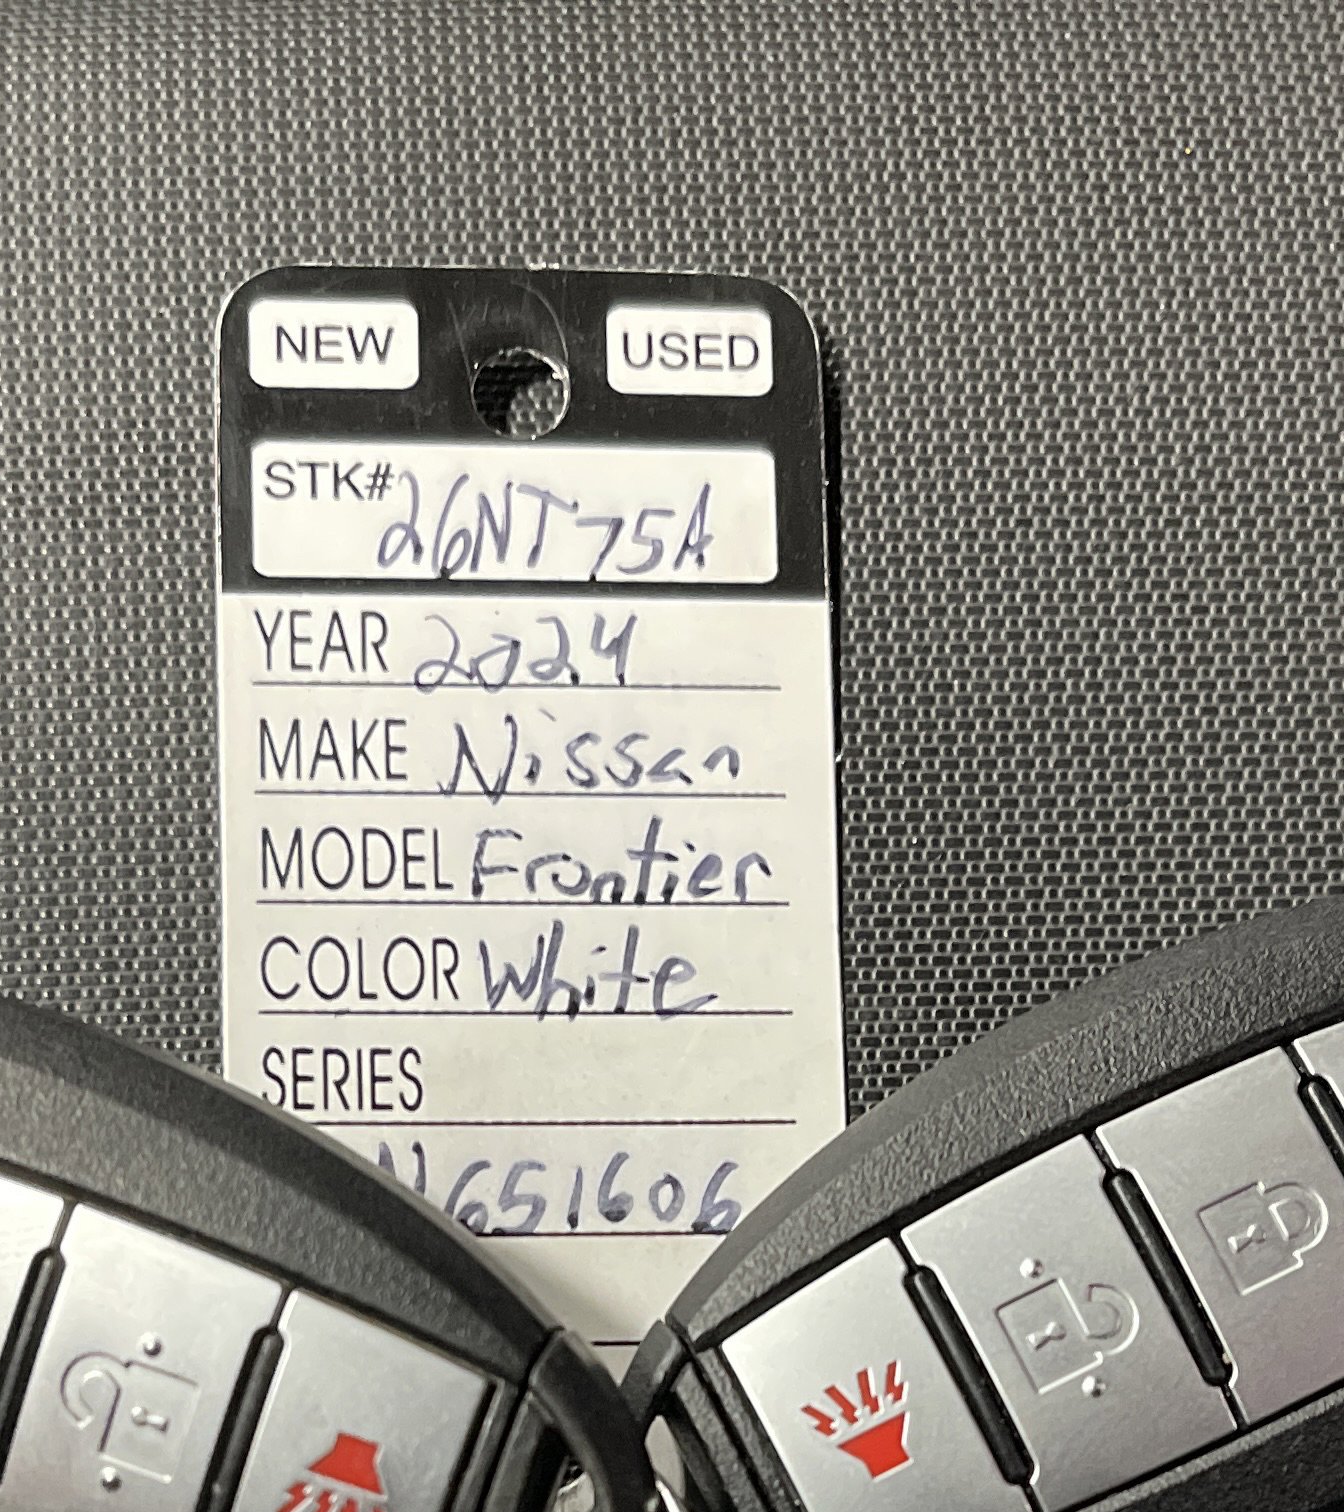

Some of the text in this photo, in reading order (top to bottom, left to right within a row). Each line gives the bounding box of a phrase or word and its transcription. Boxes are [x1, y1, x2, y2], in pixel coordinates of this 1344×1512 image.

[274, 325, 395, 363] NEW
[622, 331, 760, 371] USED
[264, 460, 394, 501] STK#
[254, 610, 389, 673] YEAR
[413, 612, 638, 693] 2024
[258, 718, 408, 781] MAKE
[436, 707, 741, 805] Nissan
[260, 827, 455, 892] MODEL
[471, 815, 773, 905] Frontier
[260, 936, 460, 1001] COLOR
[478, 919, 719, 1022] White
[261, 1046, 424, 1112] SERIES
